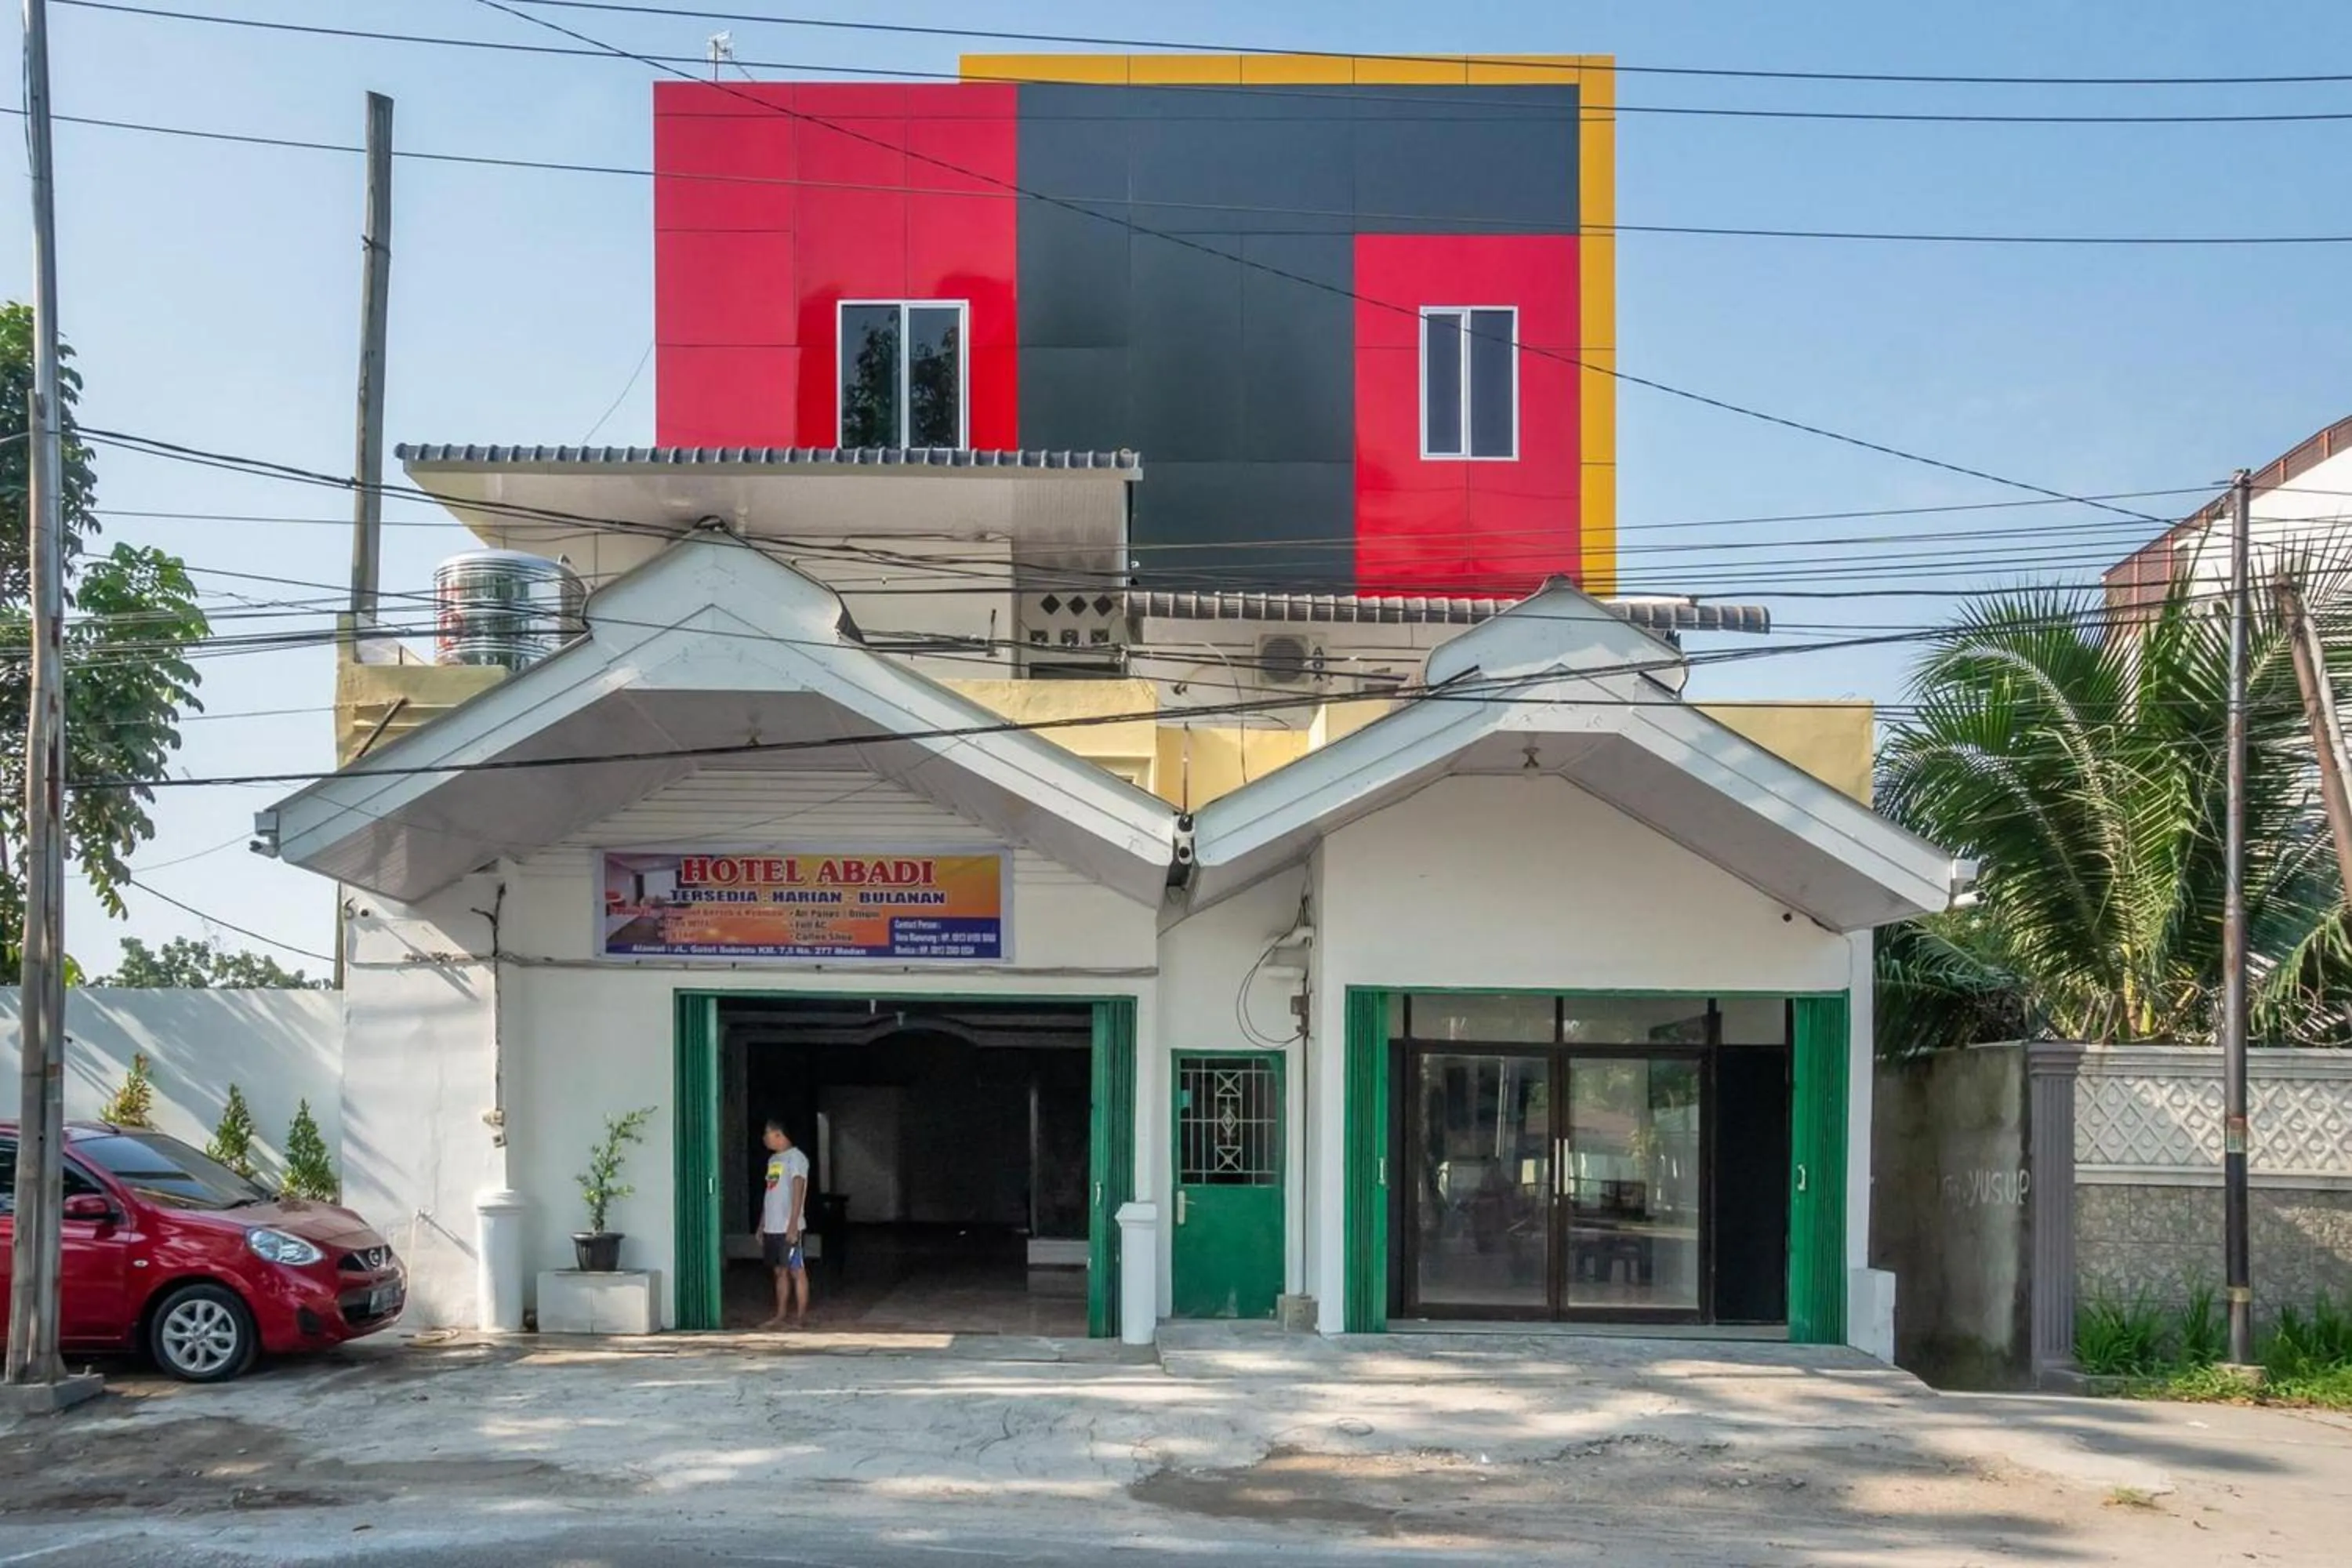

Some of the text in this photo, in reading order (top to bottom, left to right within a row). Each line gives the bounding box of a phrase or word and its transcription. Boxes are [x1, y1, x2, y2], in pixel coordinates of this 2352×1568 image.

[681, 858, 937, 887] HOTEL ABADI
[669, 888, 759, 902] TERSEDIA
[771, 891, 843, 903] HARIAN
[858, 891, 946, 904] BULANAN
